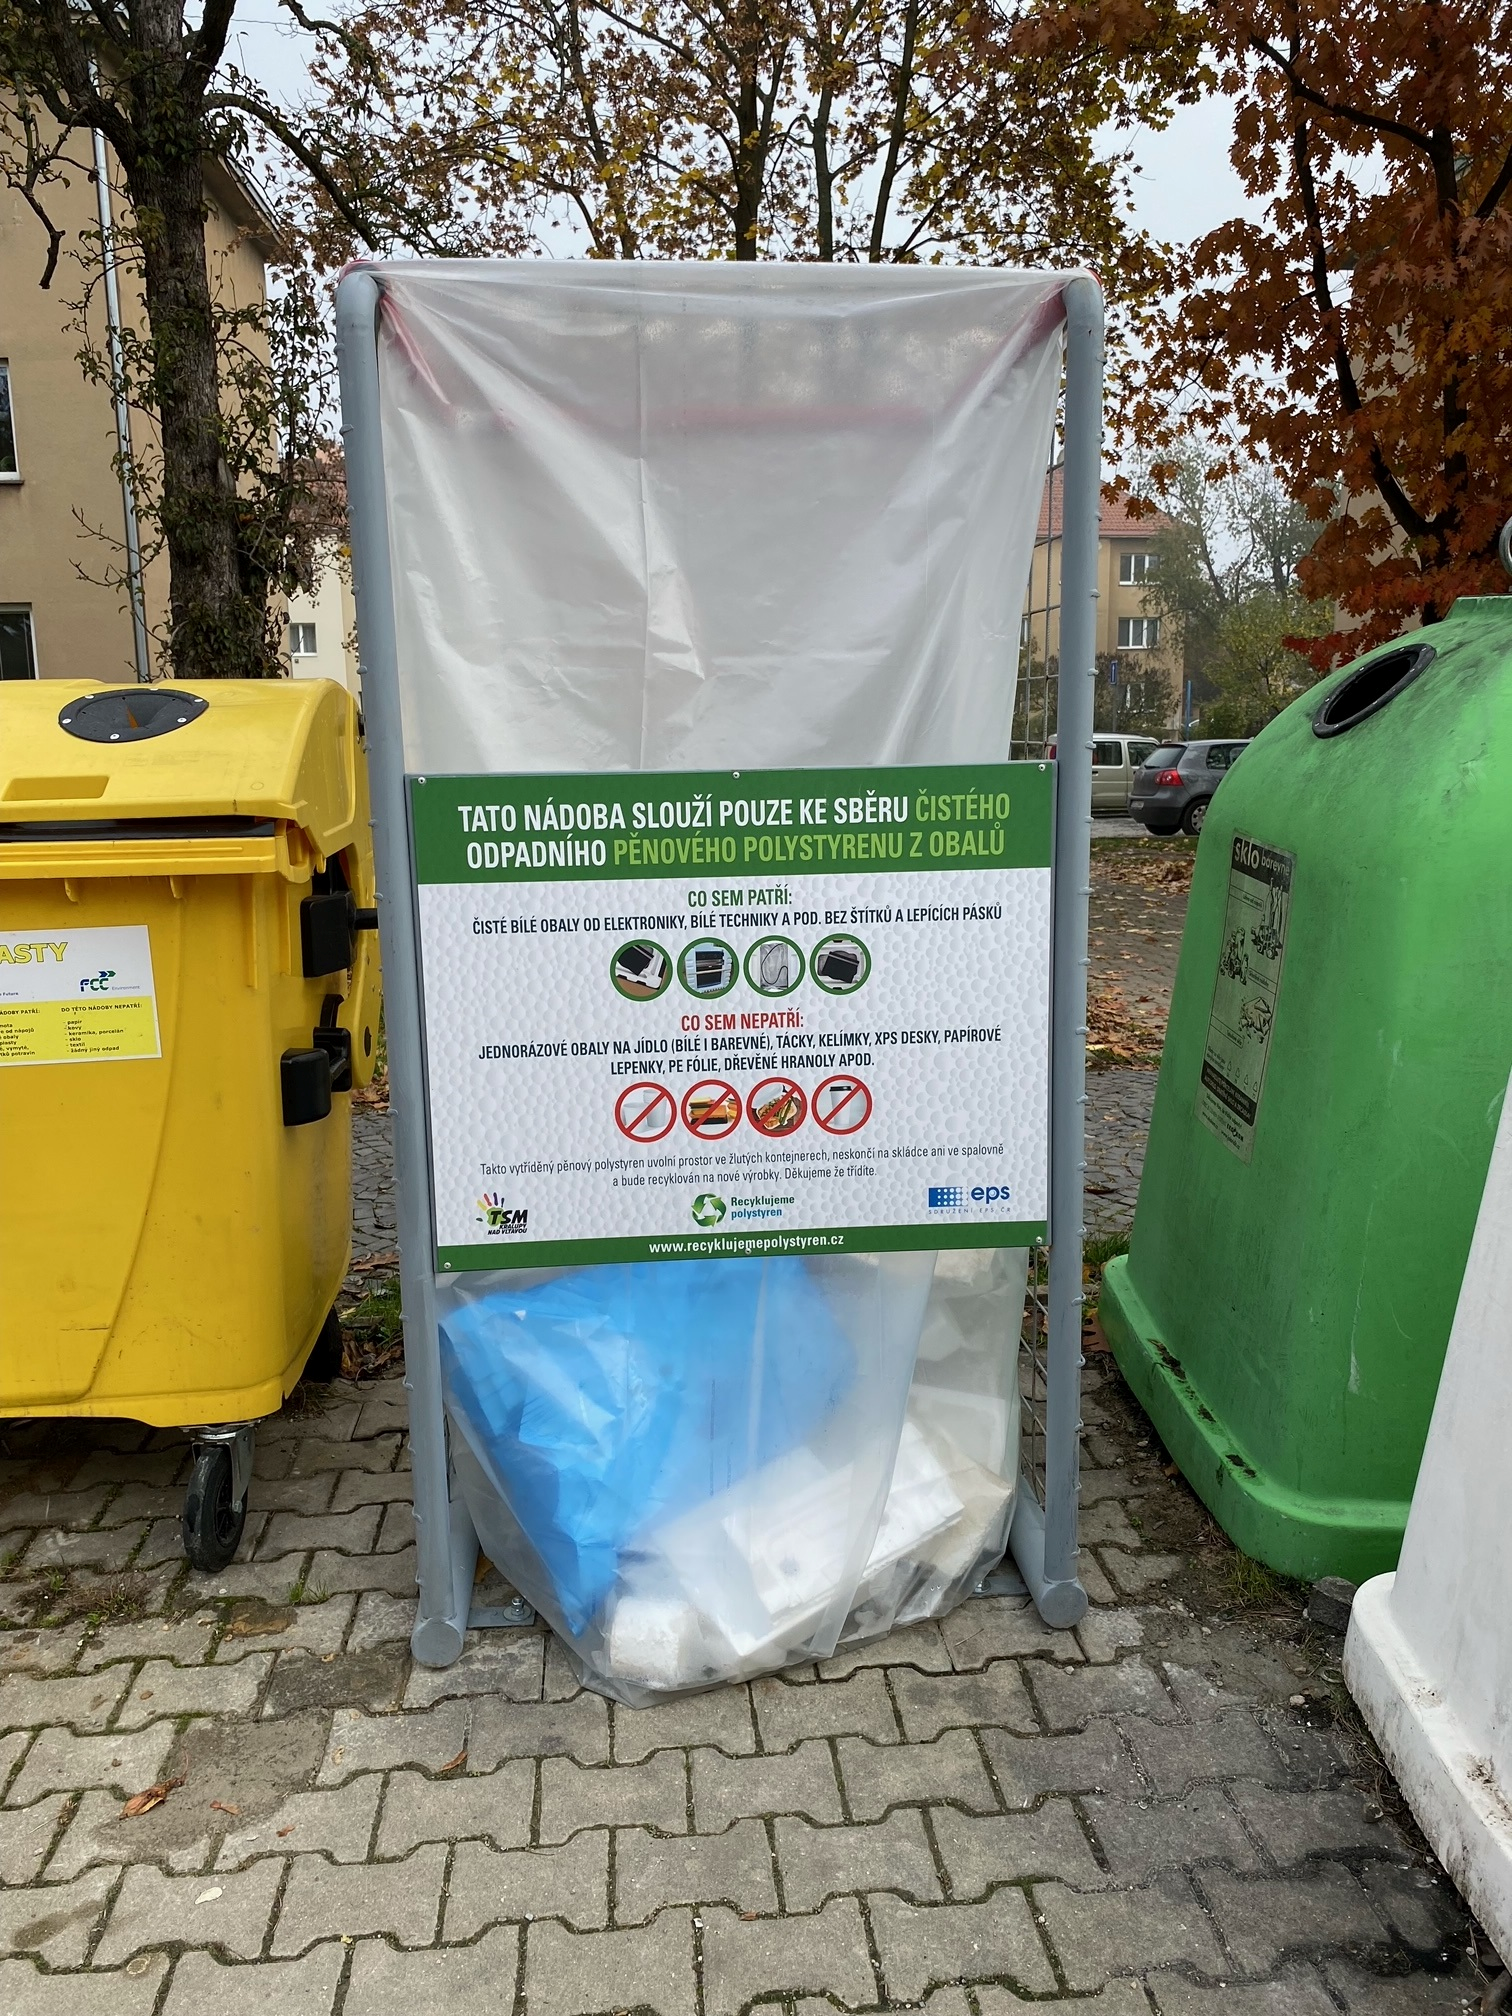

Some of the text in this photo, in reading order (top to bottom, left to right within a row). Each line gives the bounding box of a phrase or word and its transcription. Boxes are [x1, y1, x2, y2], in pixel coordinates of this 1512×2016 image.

[458, 787, 1010, 832] TATO NÁDOBA SLOUŽÍ POUZE KE SBĚRU ČISTÉHO
[467, 821, 1005, 869] ODPADNÍHO PĚNOVÉHO POLYSTYRENU Z OBALŮ
[1234, 838, 1260, 869] sklo
[688, 883, 793, 908] CO SEM PATŘÍ:
[473, 901, 1002, 935] ČISTÉ BÍLÉ OBALY OD ELEKTRONIKY, BÍLÉ TECHNIKY A POD. BEZ ŠTÍTKŮ A LEPÍCÍCH PÁSKŮ
[681, 1007, 804, 1031] CO SEM NEPATŘÍ:
[479, 1025, 1002, 1060] JEDNORÁZOVÉ OBALY NA JÍDLO (BÍLÉ I BAREVNÉ), TÁCKY, KELÍMKY, XPS DESKY, PAPÍROVÉ
[611, 1052, 875, 1077] LEPENKY, PE FÓLIE, DŘEVĚNÉ HRANOLY APOD.
[480, 1143, 1004, 1177] Takto vytříděný pěnový polystyren uvolní prostor ve žlutých kontejnerech, neskončí na skládce ani ve spalovně
[612, 1164, 877, 1187] a bude recyklován na nové výrobky. Děkujeme že třídíte.
[731, 1195, 795, 1208] Recyklujeme
[971, 1185, 1011, 1204] eps
[490, 1209, 528, 1225] TSM
[731, 1208, 783, 1220] polystyren
[649, 1235, 845, 1254] www.recyklujemepolystyren.cz
